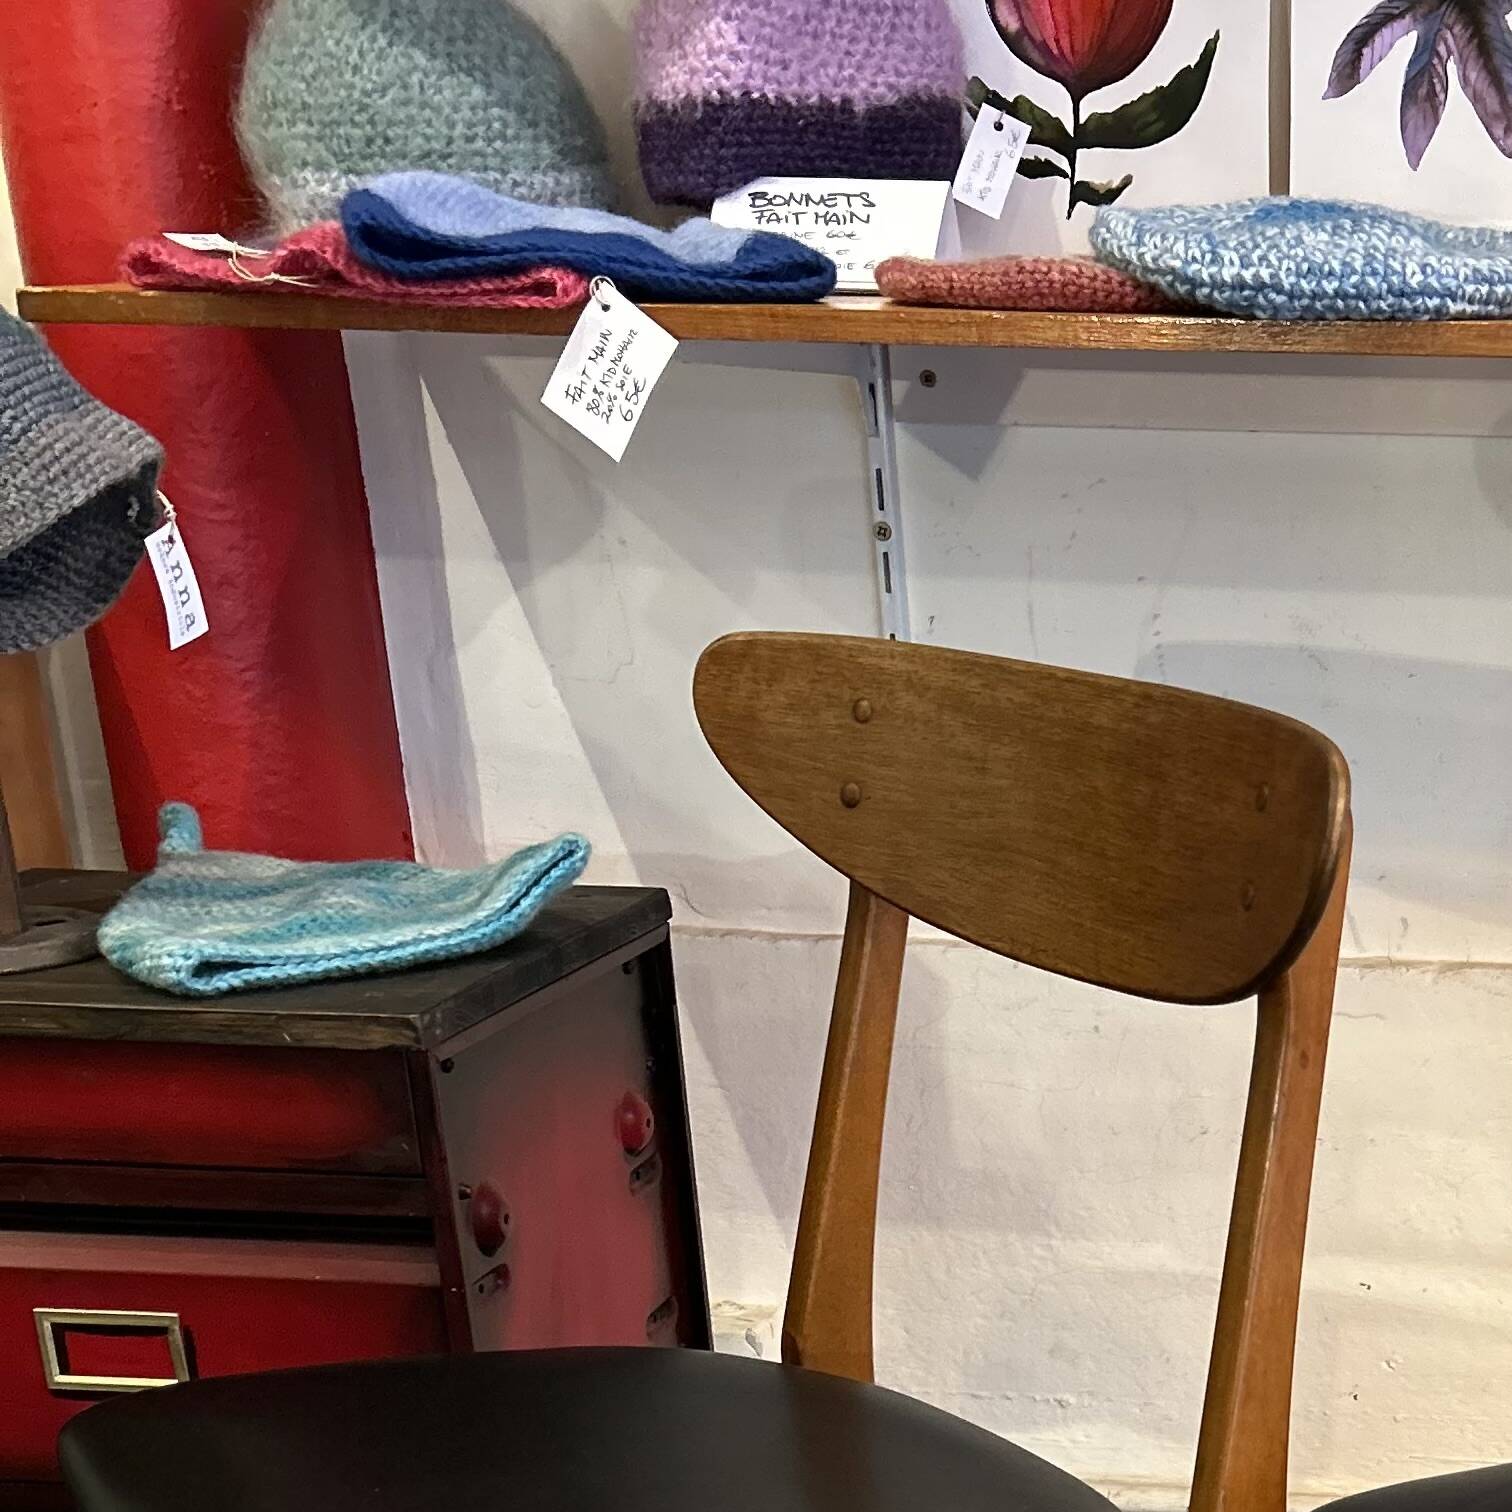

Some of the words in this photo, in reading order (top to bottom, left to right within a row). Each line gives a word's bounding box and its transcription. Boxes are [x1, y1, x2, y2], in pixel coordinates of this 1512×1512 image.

[748, 191, 876, 208] BONNETS
[752, 208, 808, 225] FAIT
[814, 210, 870, 226] MAIN
[564, 366, 592, 405] FAIT
[588, 328, 613, 366] MAIN
[619, 377, 647, 422] 65€
[161, 537, 196, 632] Anna
